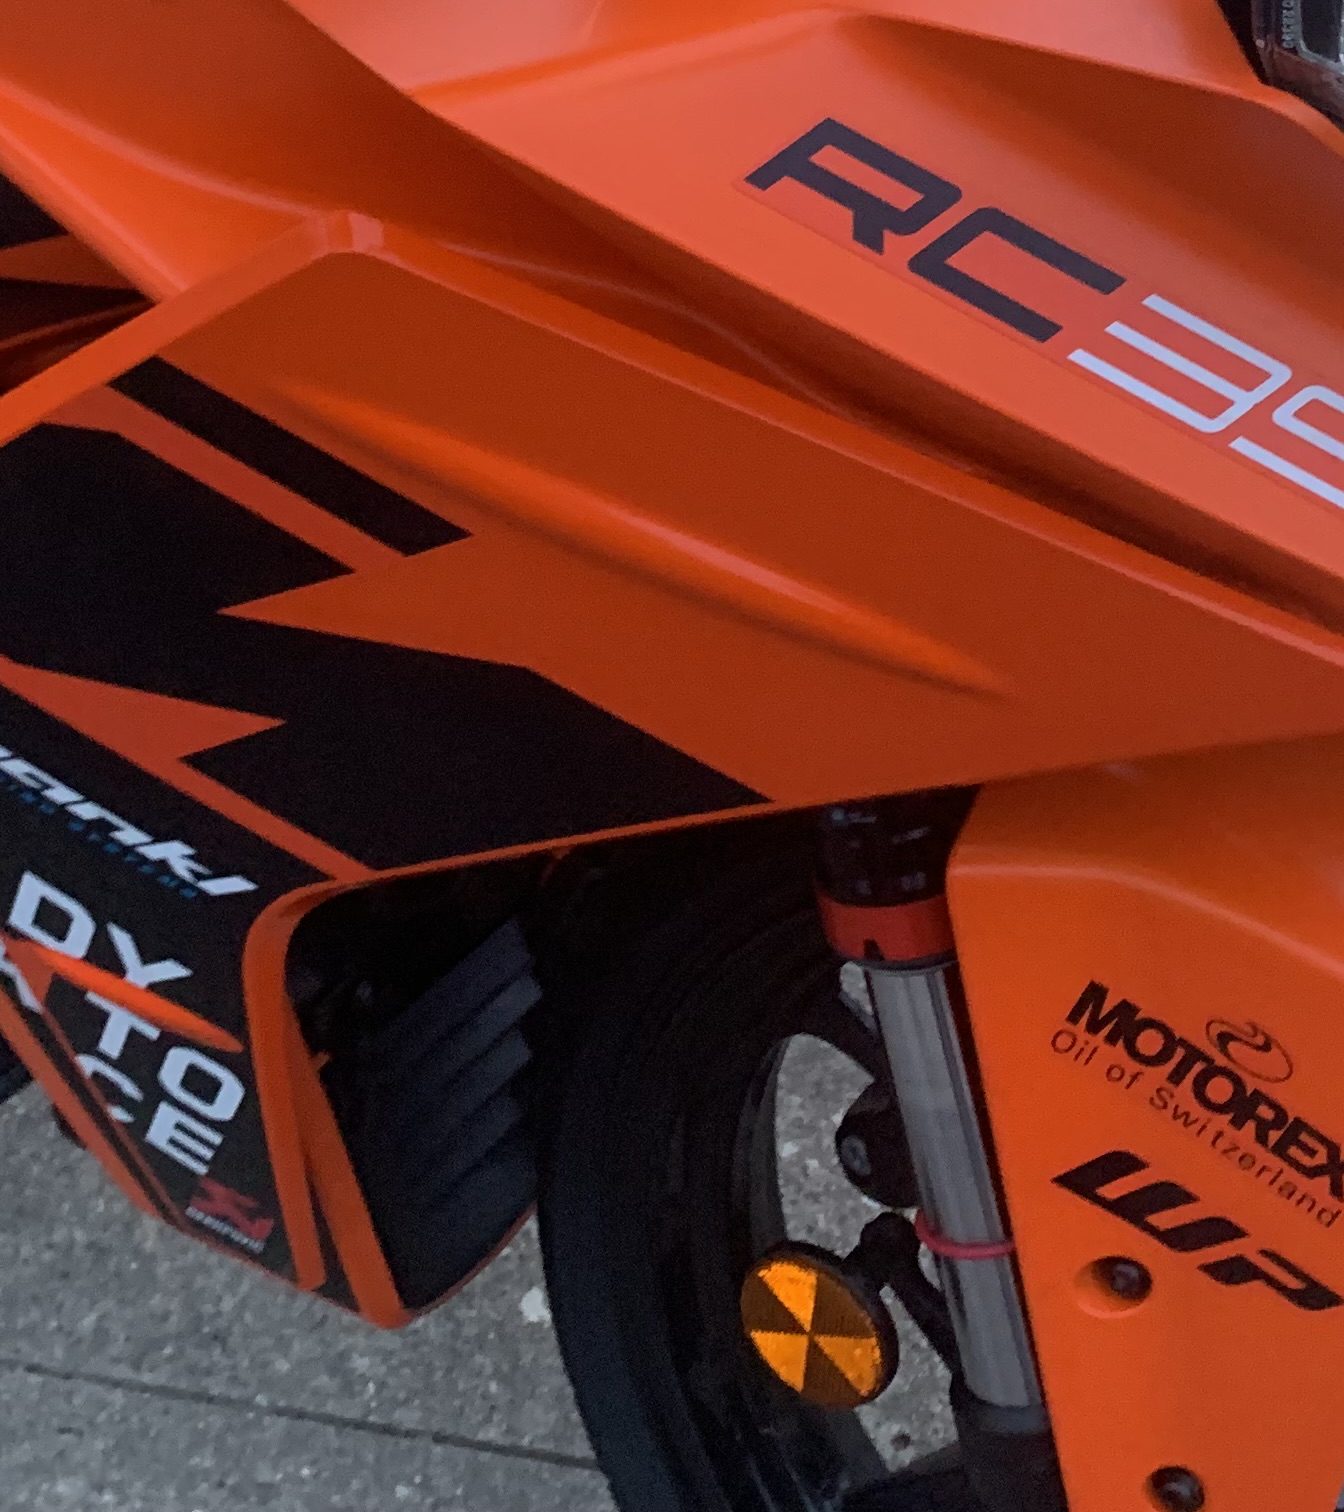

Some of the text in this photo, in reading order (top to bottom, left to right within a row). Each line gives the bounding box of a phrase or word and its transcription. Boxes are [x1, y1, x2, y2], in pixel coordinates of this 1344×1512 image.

[85, 990, 245, 1122] TO
[1050, 1028, 1343, 1228] Oil of Switzerland
